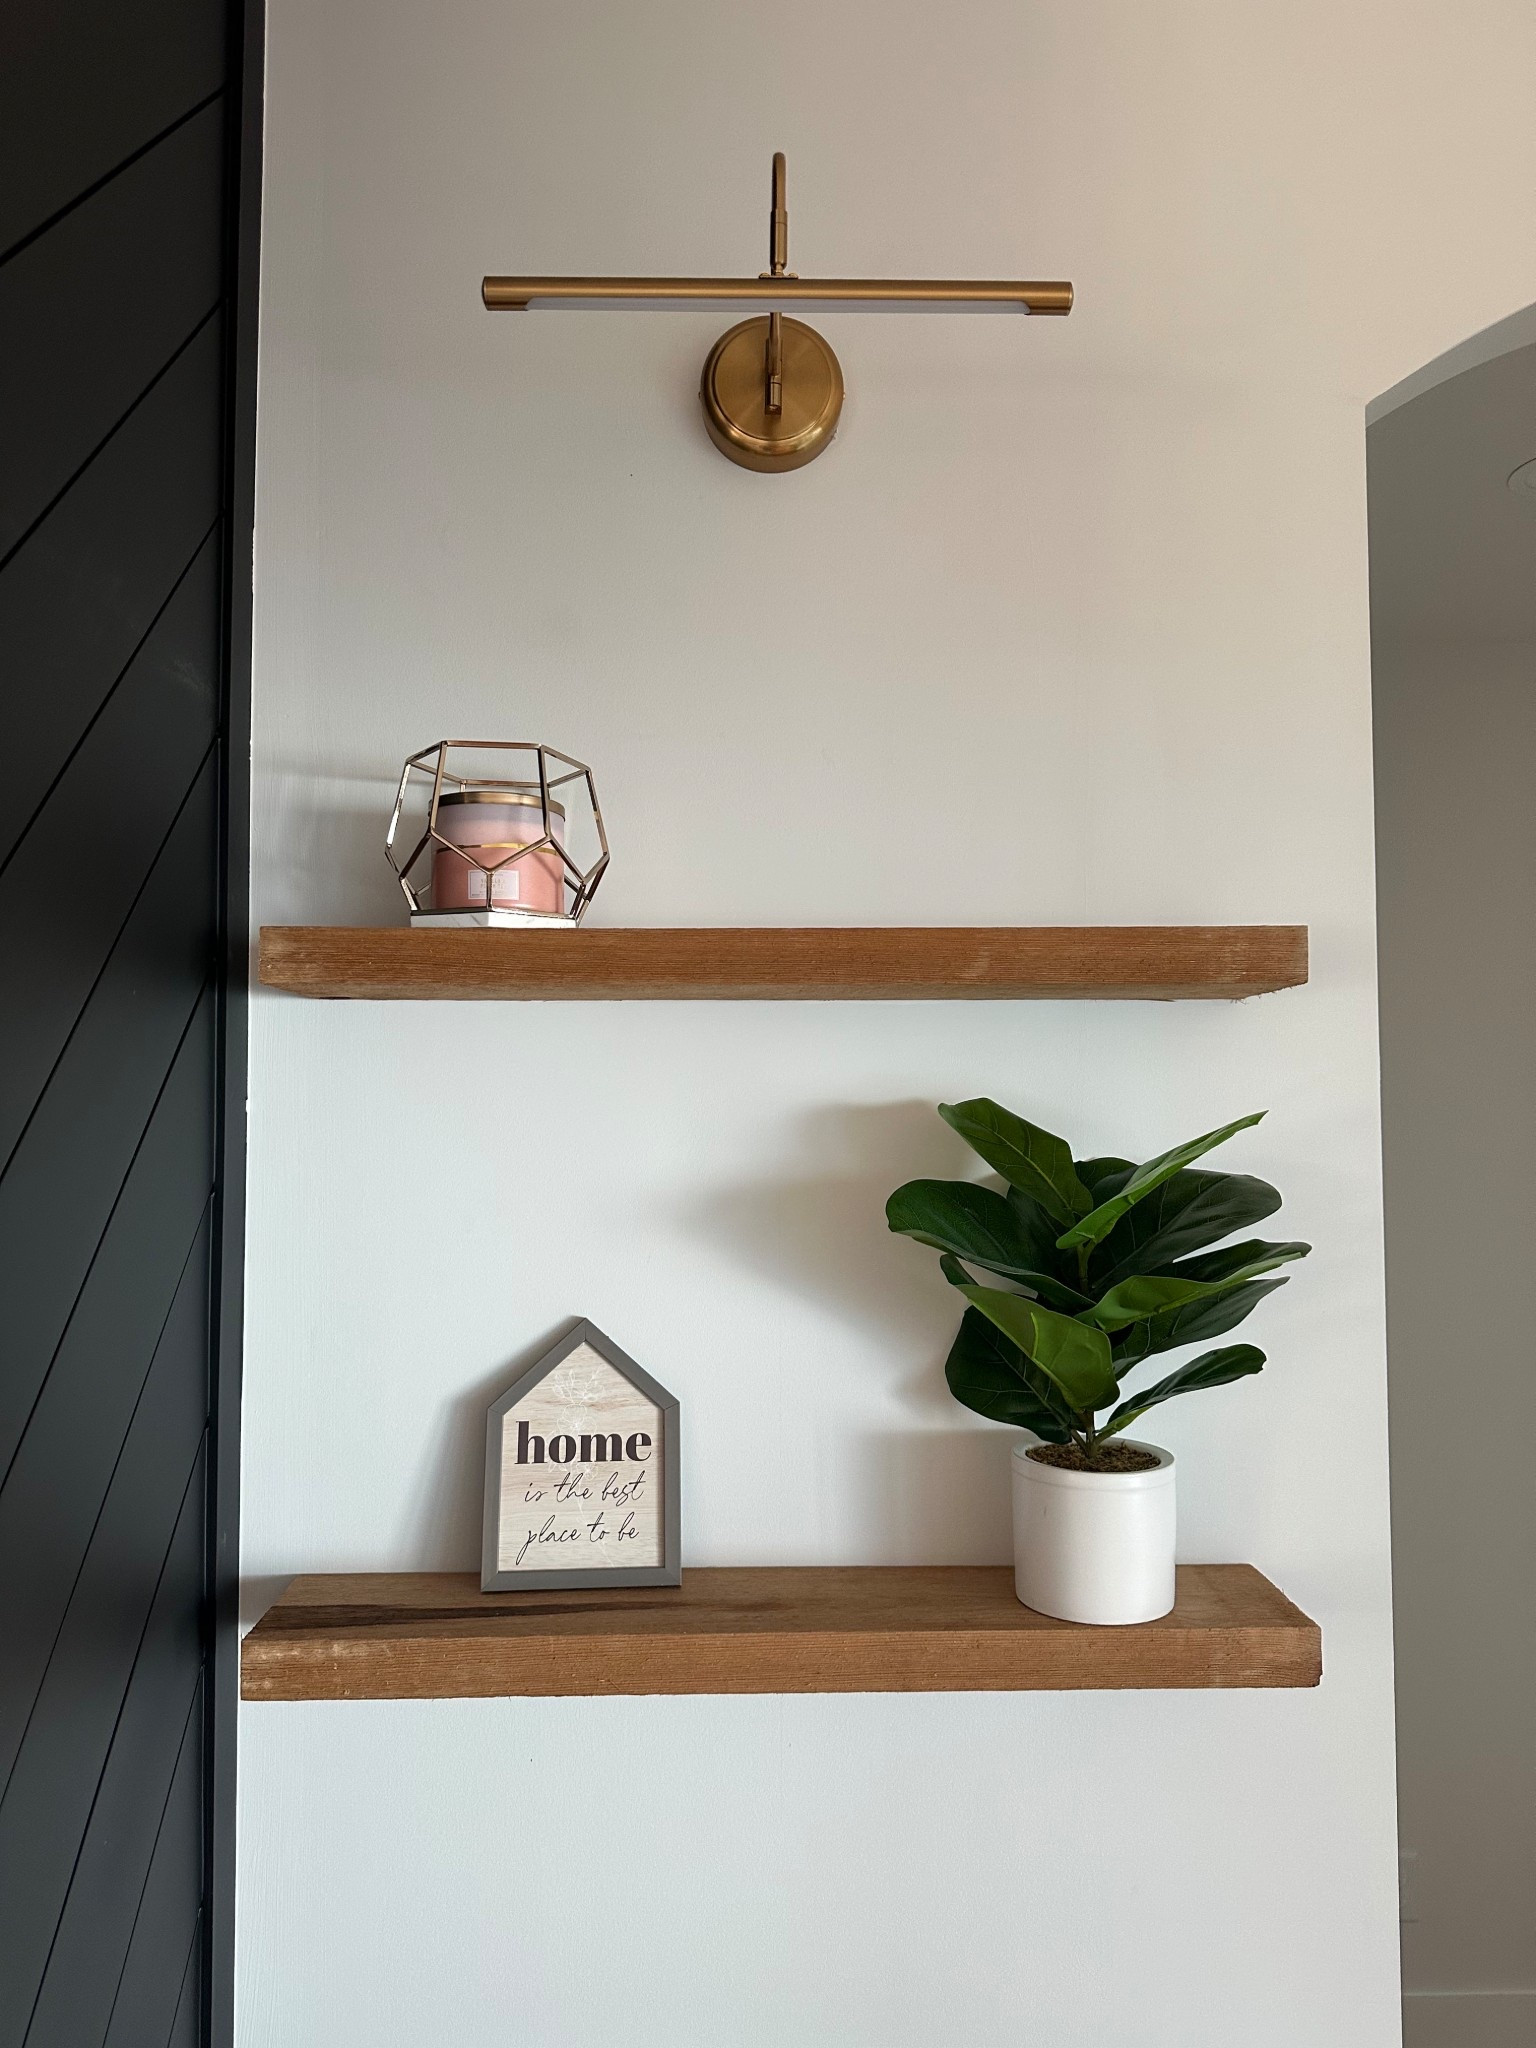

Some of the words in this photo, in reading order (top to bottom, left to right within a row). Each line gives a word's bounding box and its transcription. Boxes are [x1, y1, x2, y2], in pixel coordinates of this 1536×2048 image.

[515, 1420, 652, 1465] home
[524, 1482, 548, 1503] is
[553, 1471, 593, 1503] the
[601, 1469, 646, 1507] best
[515, 1514, 582, 1566] place
[586, 1511, 610, 1543] to
[618, 1511, 640, 1542] be
